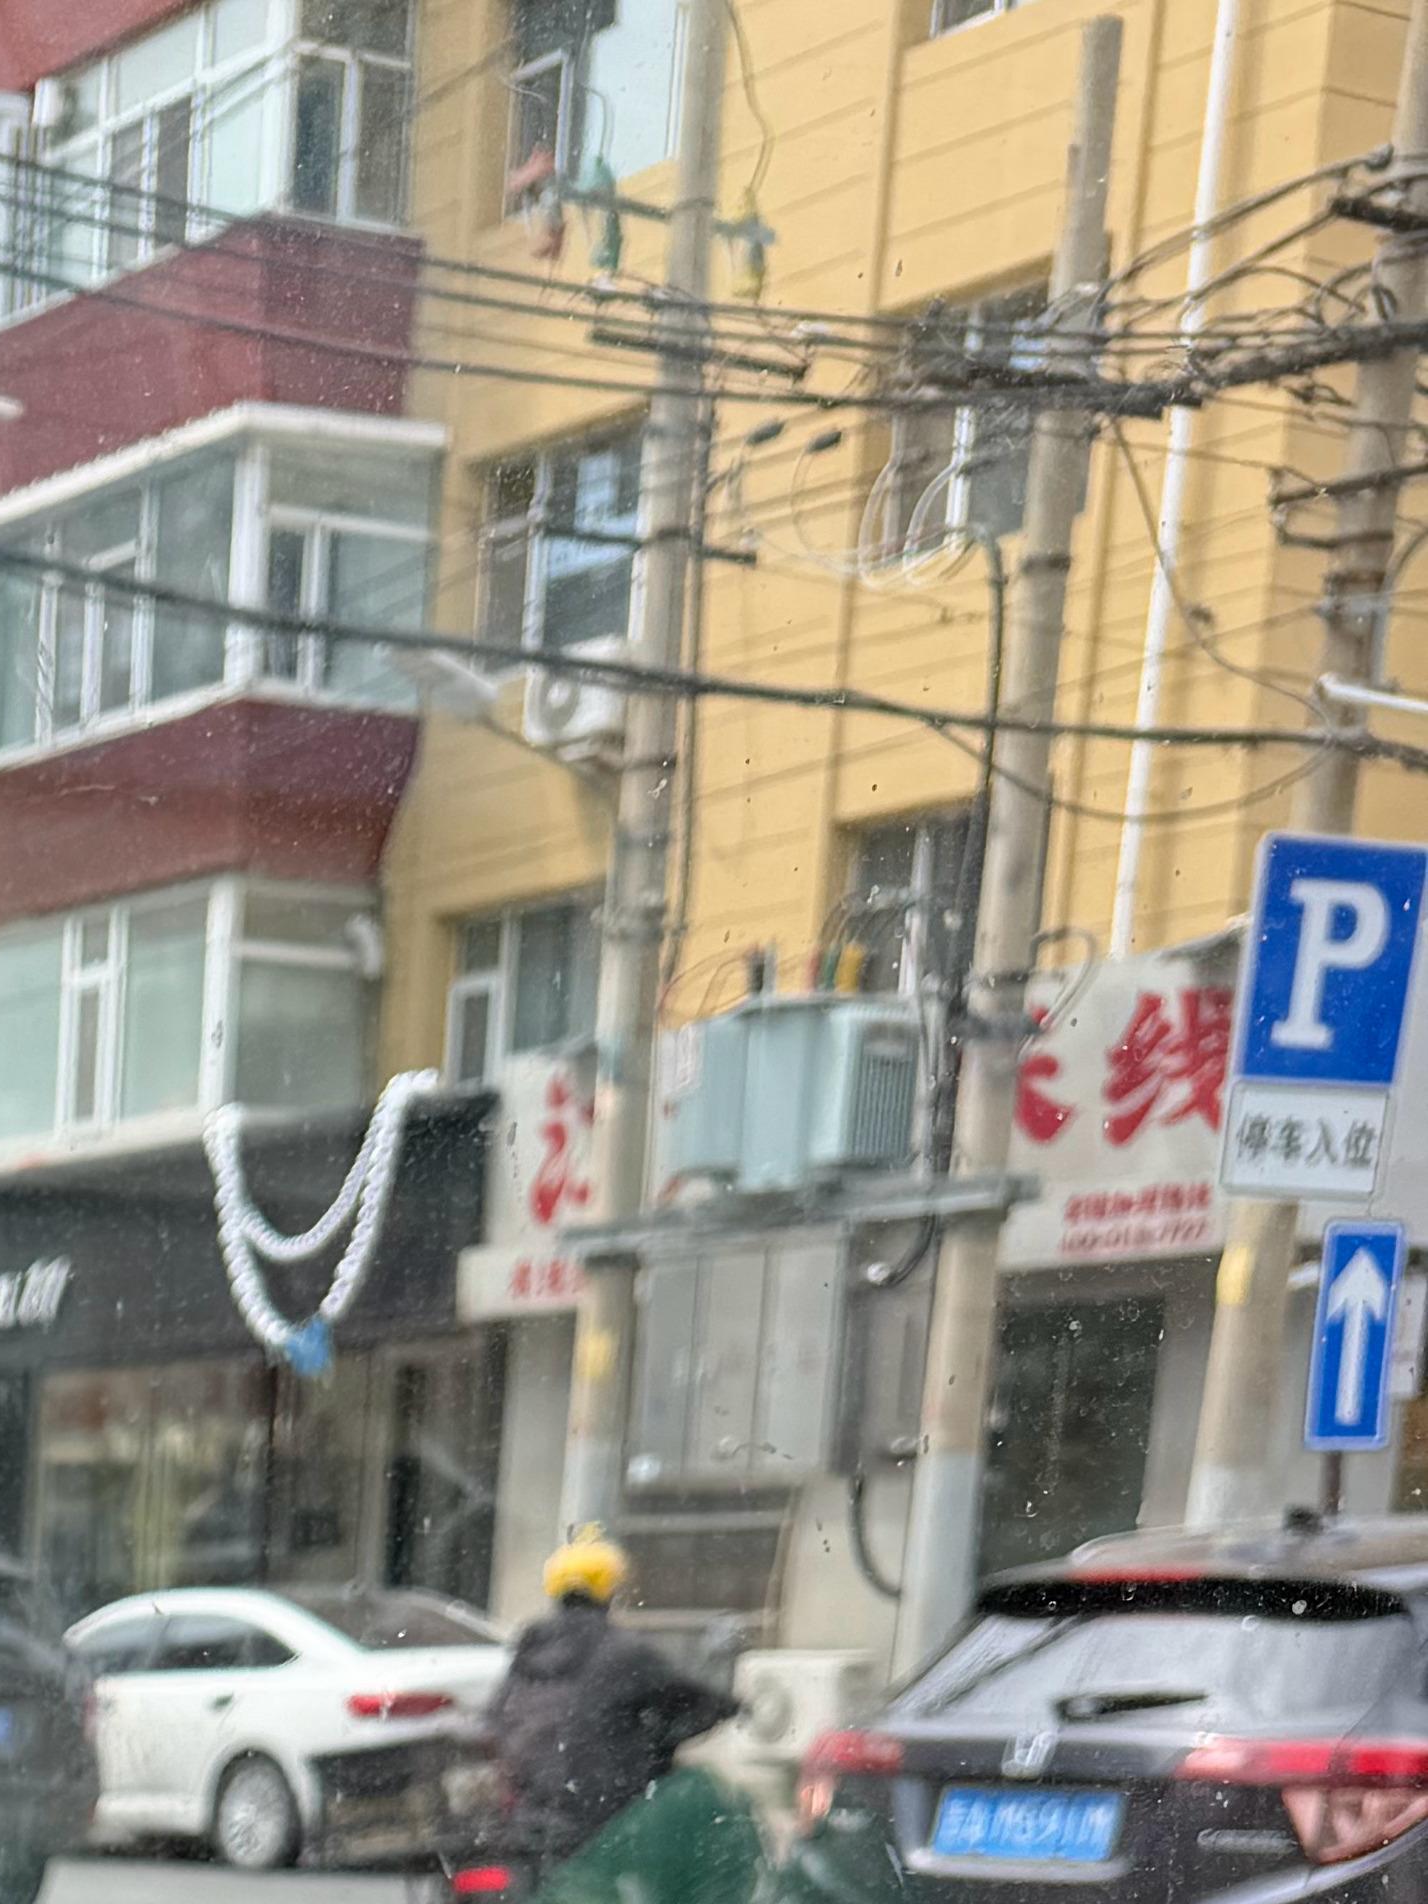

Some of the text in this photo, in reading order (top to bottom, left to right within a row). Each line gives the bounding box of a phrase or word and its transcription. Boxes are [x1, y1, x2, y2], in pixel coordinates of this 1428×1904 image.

[1270, 876, 1391, 1050] P
[1236, 1113, 1377, 1168] 停车入位
